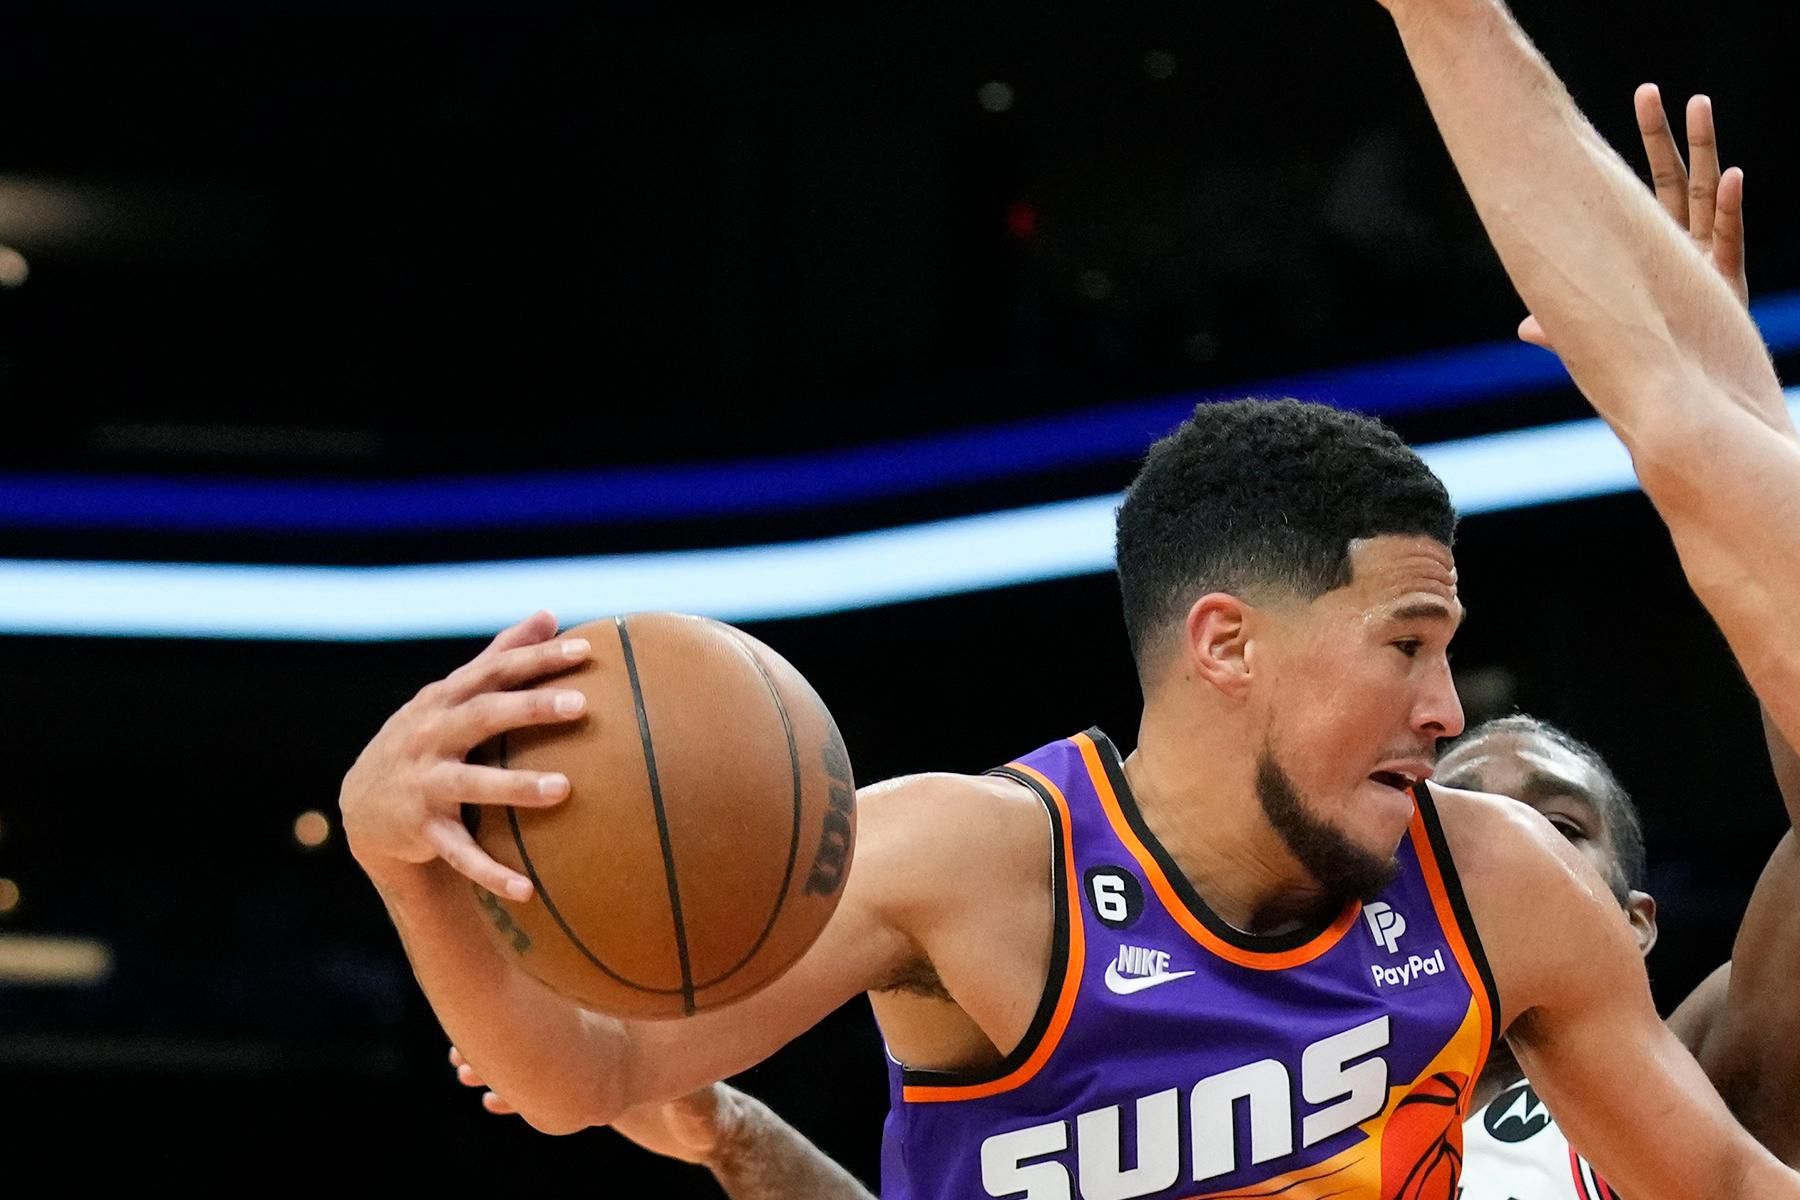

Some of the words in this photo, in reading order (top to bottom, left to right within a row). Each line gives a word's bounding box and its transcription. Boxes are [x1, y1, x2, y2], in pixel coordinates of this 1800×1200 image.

[1092, 874, 1128, 922] 6
[1117, 944, 1171, 977] NIKE
[1371, 949, 1446, 987] PayPal
